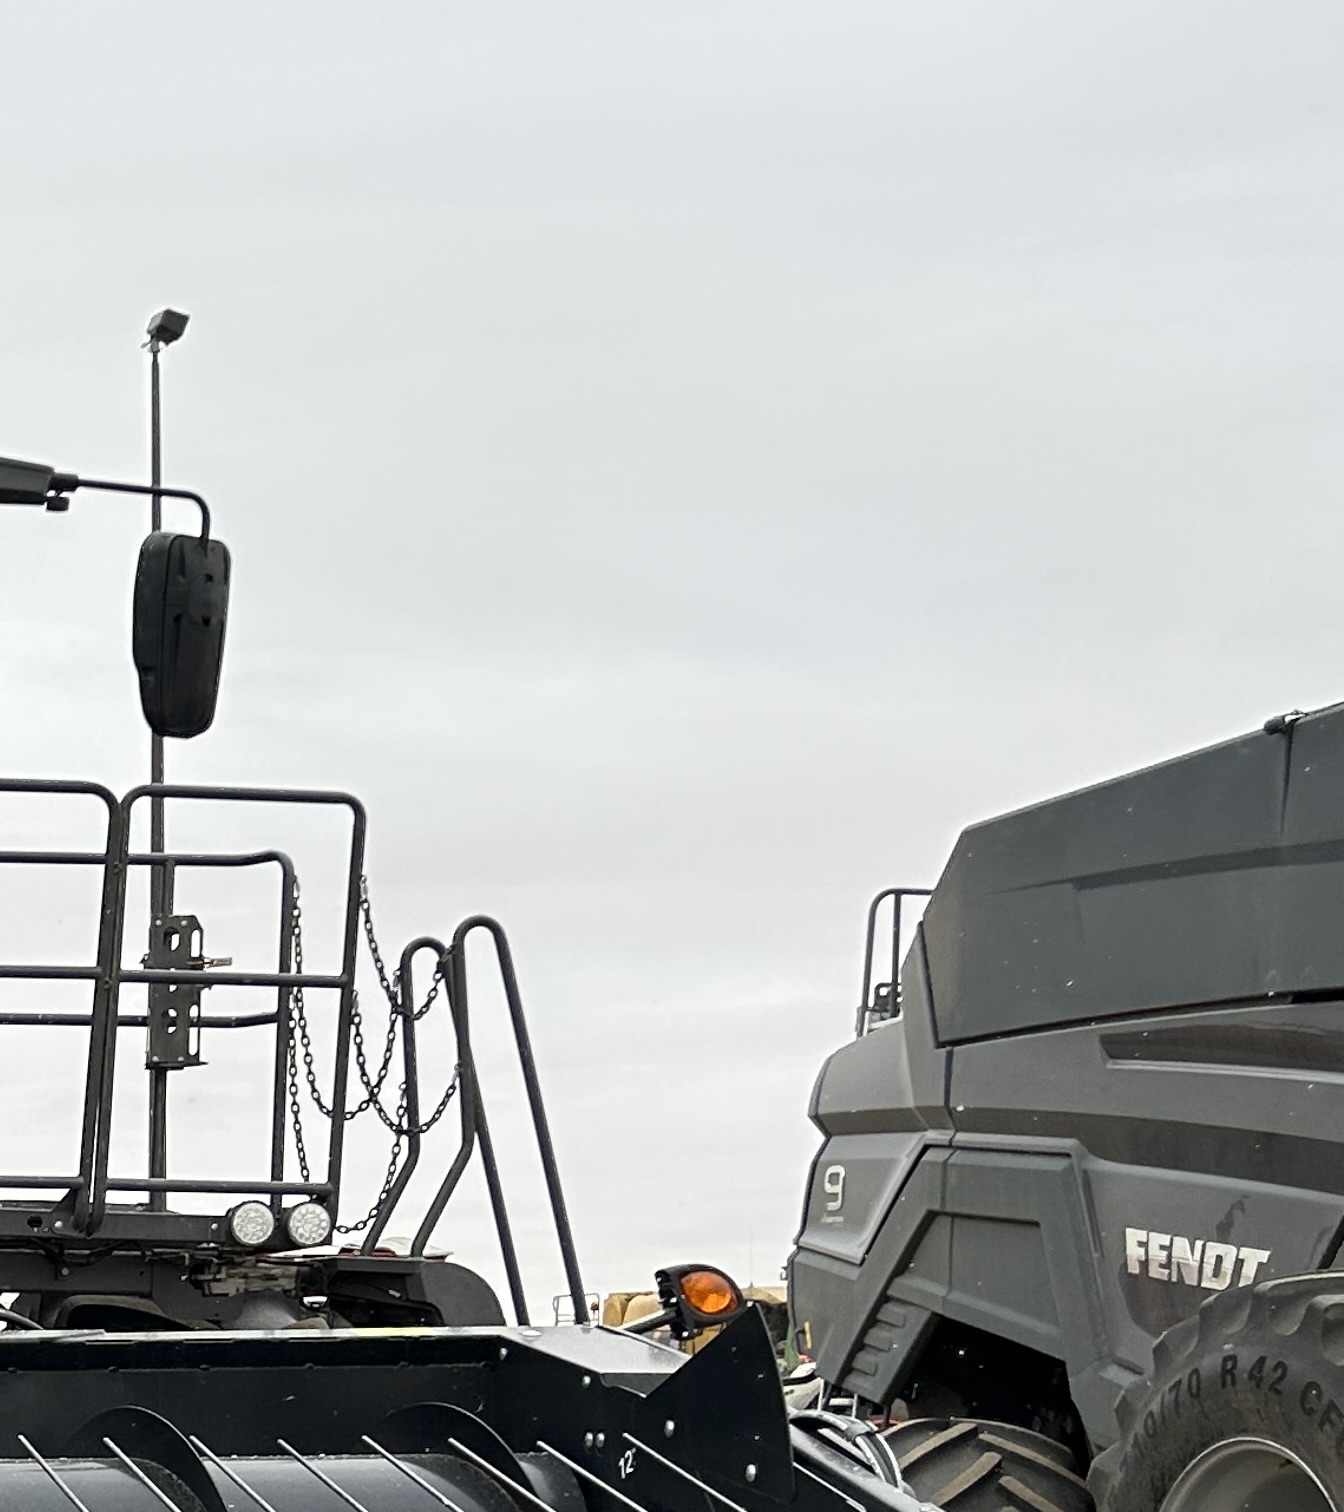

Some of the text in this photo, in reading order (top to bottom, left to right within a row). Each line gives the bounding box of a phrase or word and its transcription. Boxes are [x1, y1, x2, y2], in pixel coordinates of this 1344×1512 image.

[824, 1165, 845, 1211] 9
[1125, 1227, 1271, 1291] FENDT
[1220, 1354, 1238, 1388] R
[1247, 1355, 1288, 1395] 42
